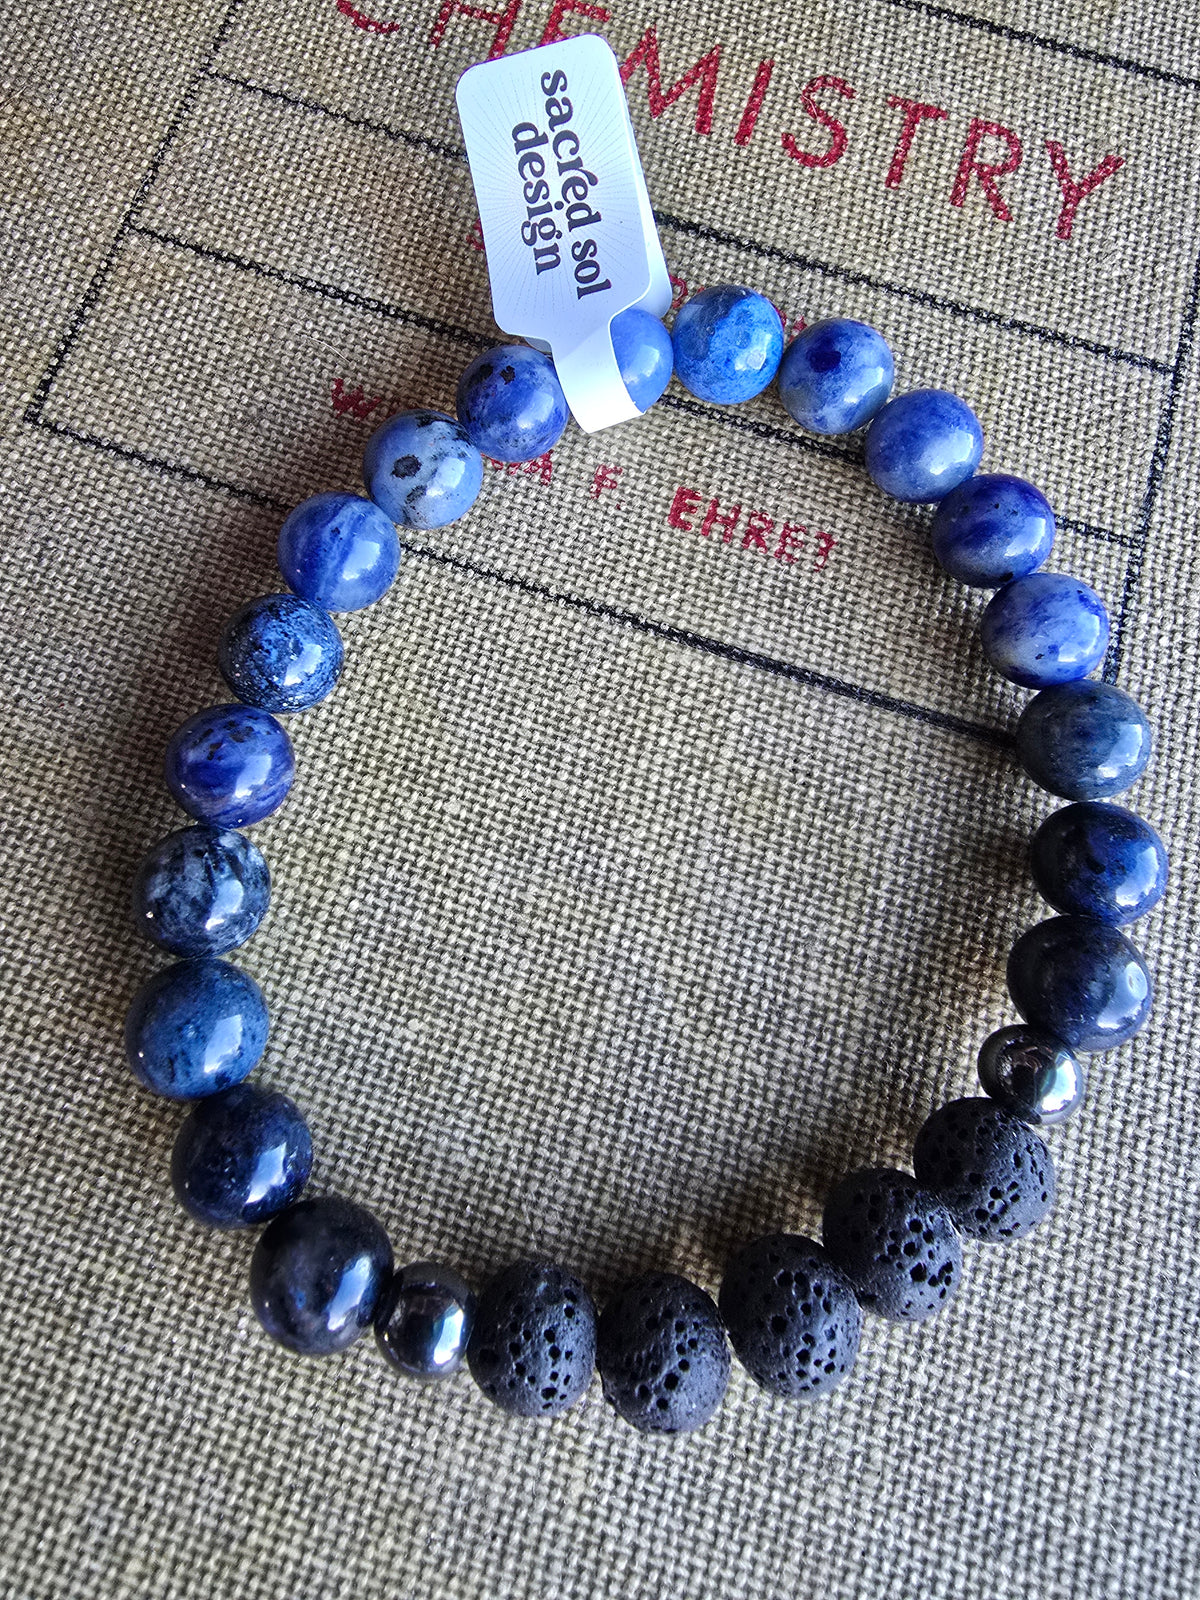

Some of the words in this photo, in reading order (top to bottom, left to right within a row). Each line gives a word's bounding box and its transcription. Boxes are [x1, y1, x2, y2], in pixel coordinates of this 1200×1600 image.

[512, 121, 564, 276] design
[541, 69, 602, 233] sacred
[571, 238, 612, 300] sol
